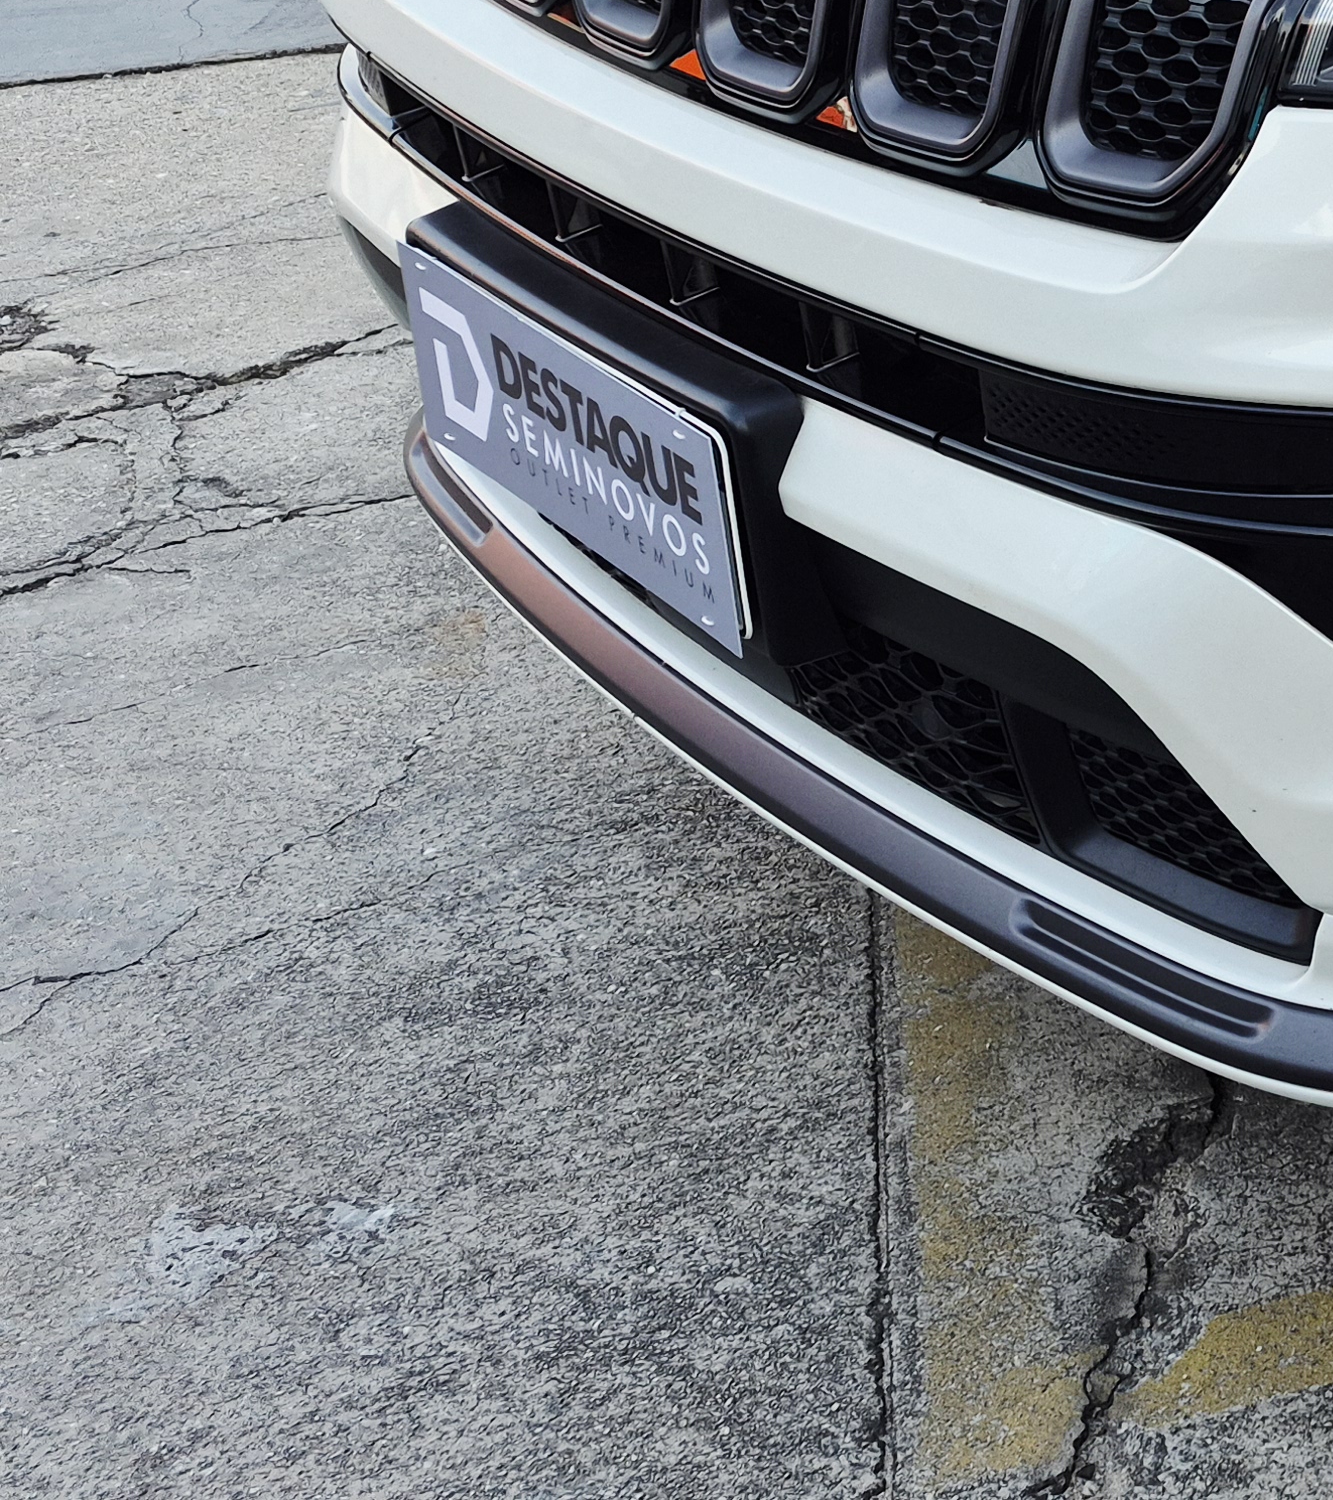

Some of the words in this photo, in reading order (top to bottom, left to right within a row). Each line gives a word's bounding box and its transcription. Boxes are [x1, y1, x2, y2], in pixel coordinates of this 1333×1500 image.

[490, 333, 702, 526] DESTAQUE
[502, 403, 710, 575] SEMINOVOS
[510, 447, 590, 516] OUTLET
[609, 515, 715, 604] PREMIUM
